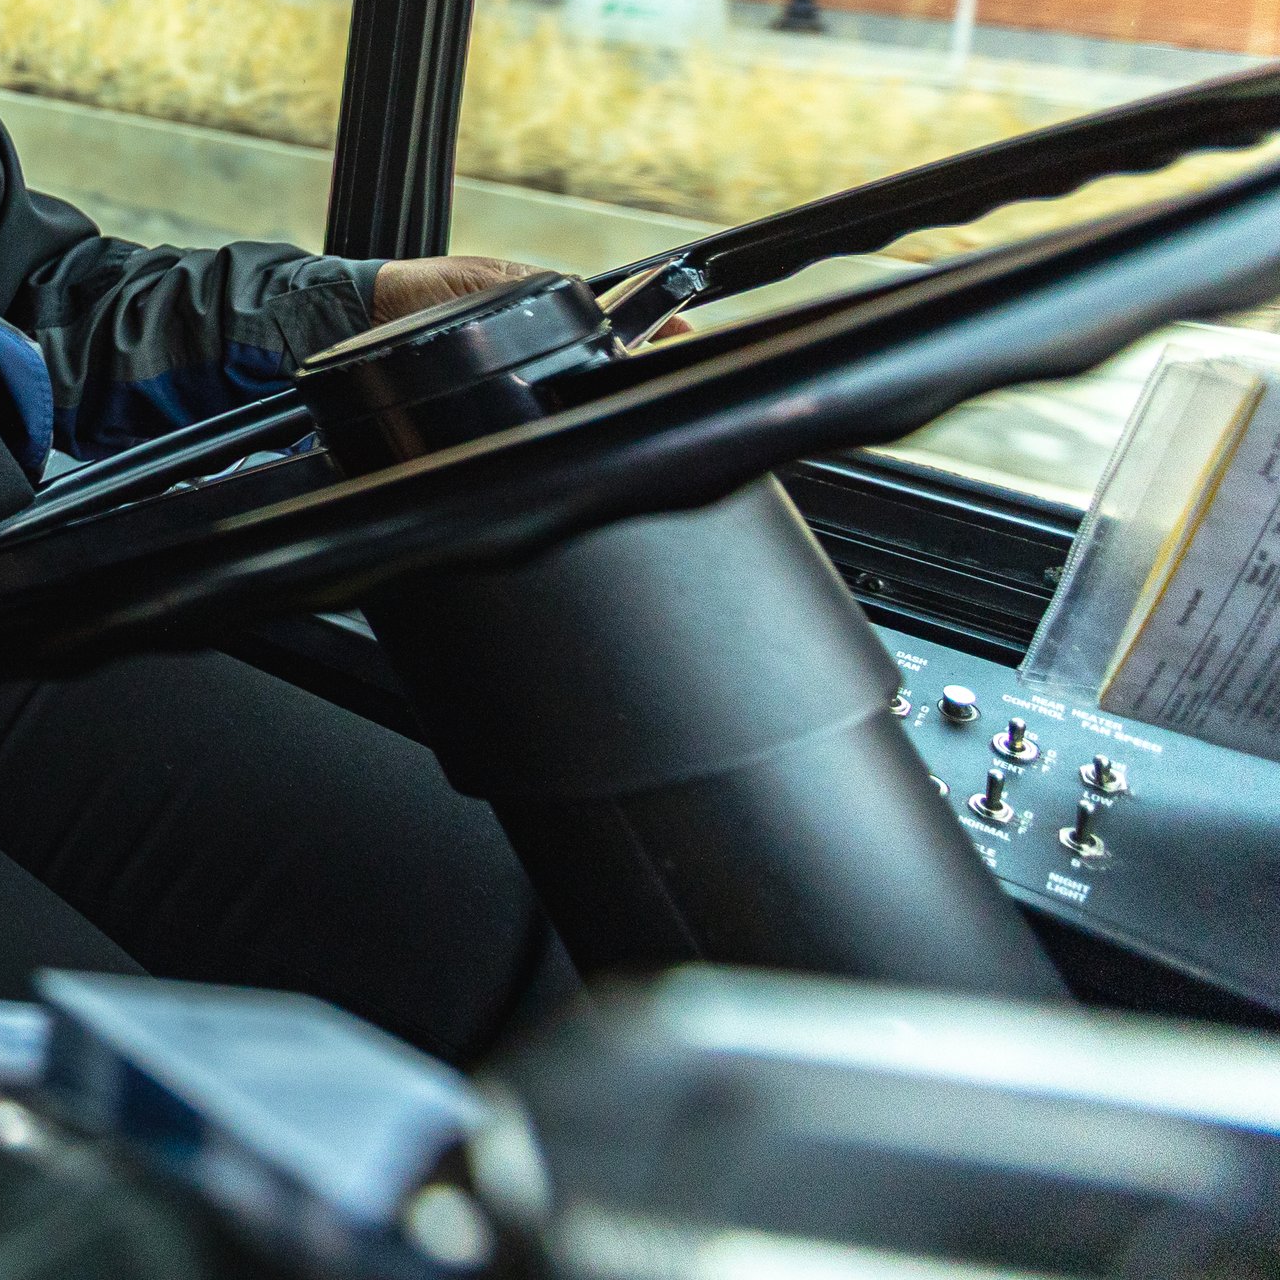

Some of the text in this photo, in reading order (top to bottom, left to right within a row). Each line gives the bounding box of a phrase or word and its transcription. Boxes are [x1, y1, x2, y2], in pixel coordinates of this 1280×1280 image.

[896, 650, 928, 666] DASH
[897, 659, 921, 672] FAN
[1002, 694, 1065, 721] CONTROL
[1031, 695, 1124, 731] REAR HEATER
[1081, 720, 1163, 753] FAN SPEED
[992, 758, 1026, 775] VENT
[1083, 791, 1114, 807] LOW
[958, 814, 1011, 842] NORMAL
[1046, 881, 1088, 903] LIGHT
[1048, 871, 1091, 894] NIGHT
